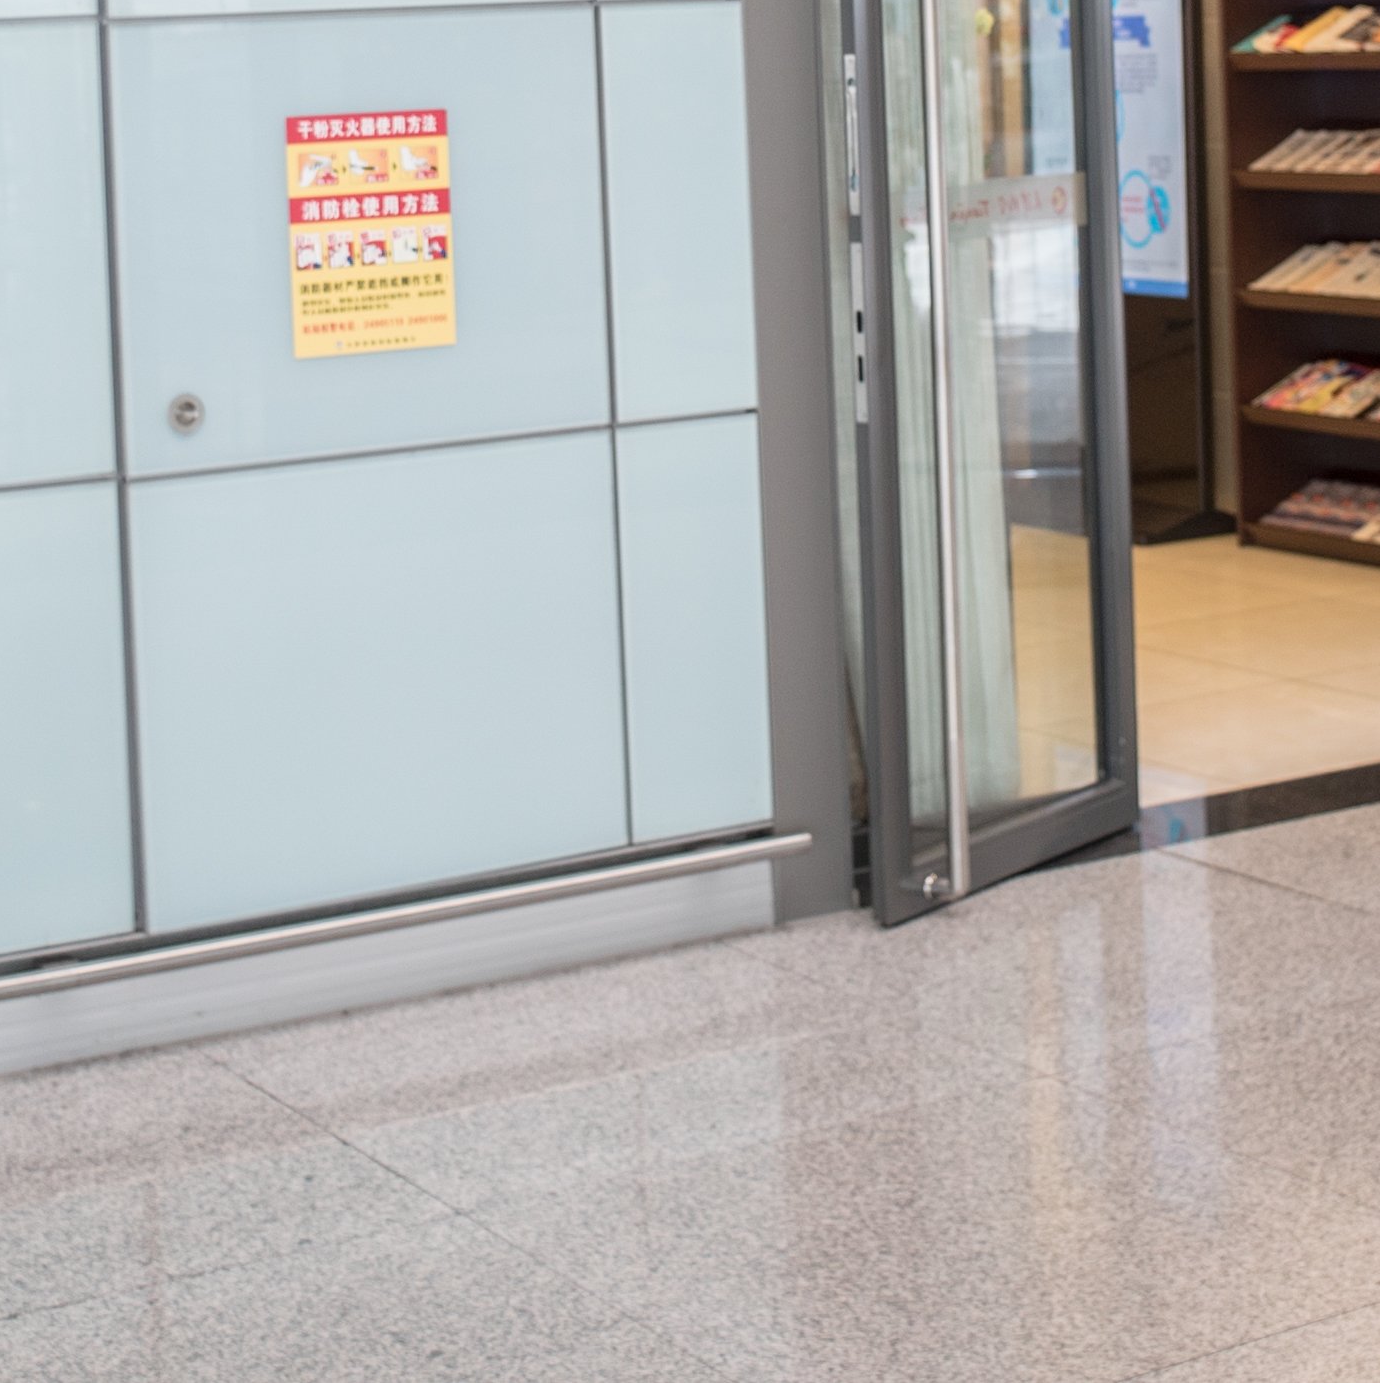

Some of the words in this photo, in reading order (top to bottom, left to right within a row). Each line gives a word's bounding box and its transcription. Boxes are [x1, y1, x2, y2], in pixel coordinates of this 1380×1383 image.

[298, 115, 437, 139] 干粉灭火器使用方法
[302, 193, 439, 221] 消防栓使用方法
